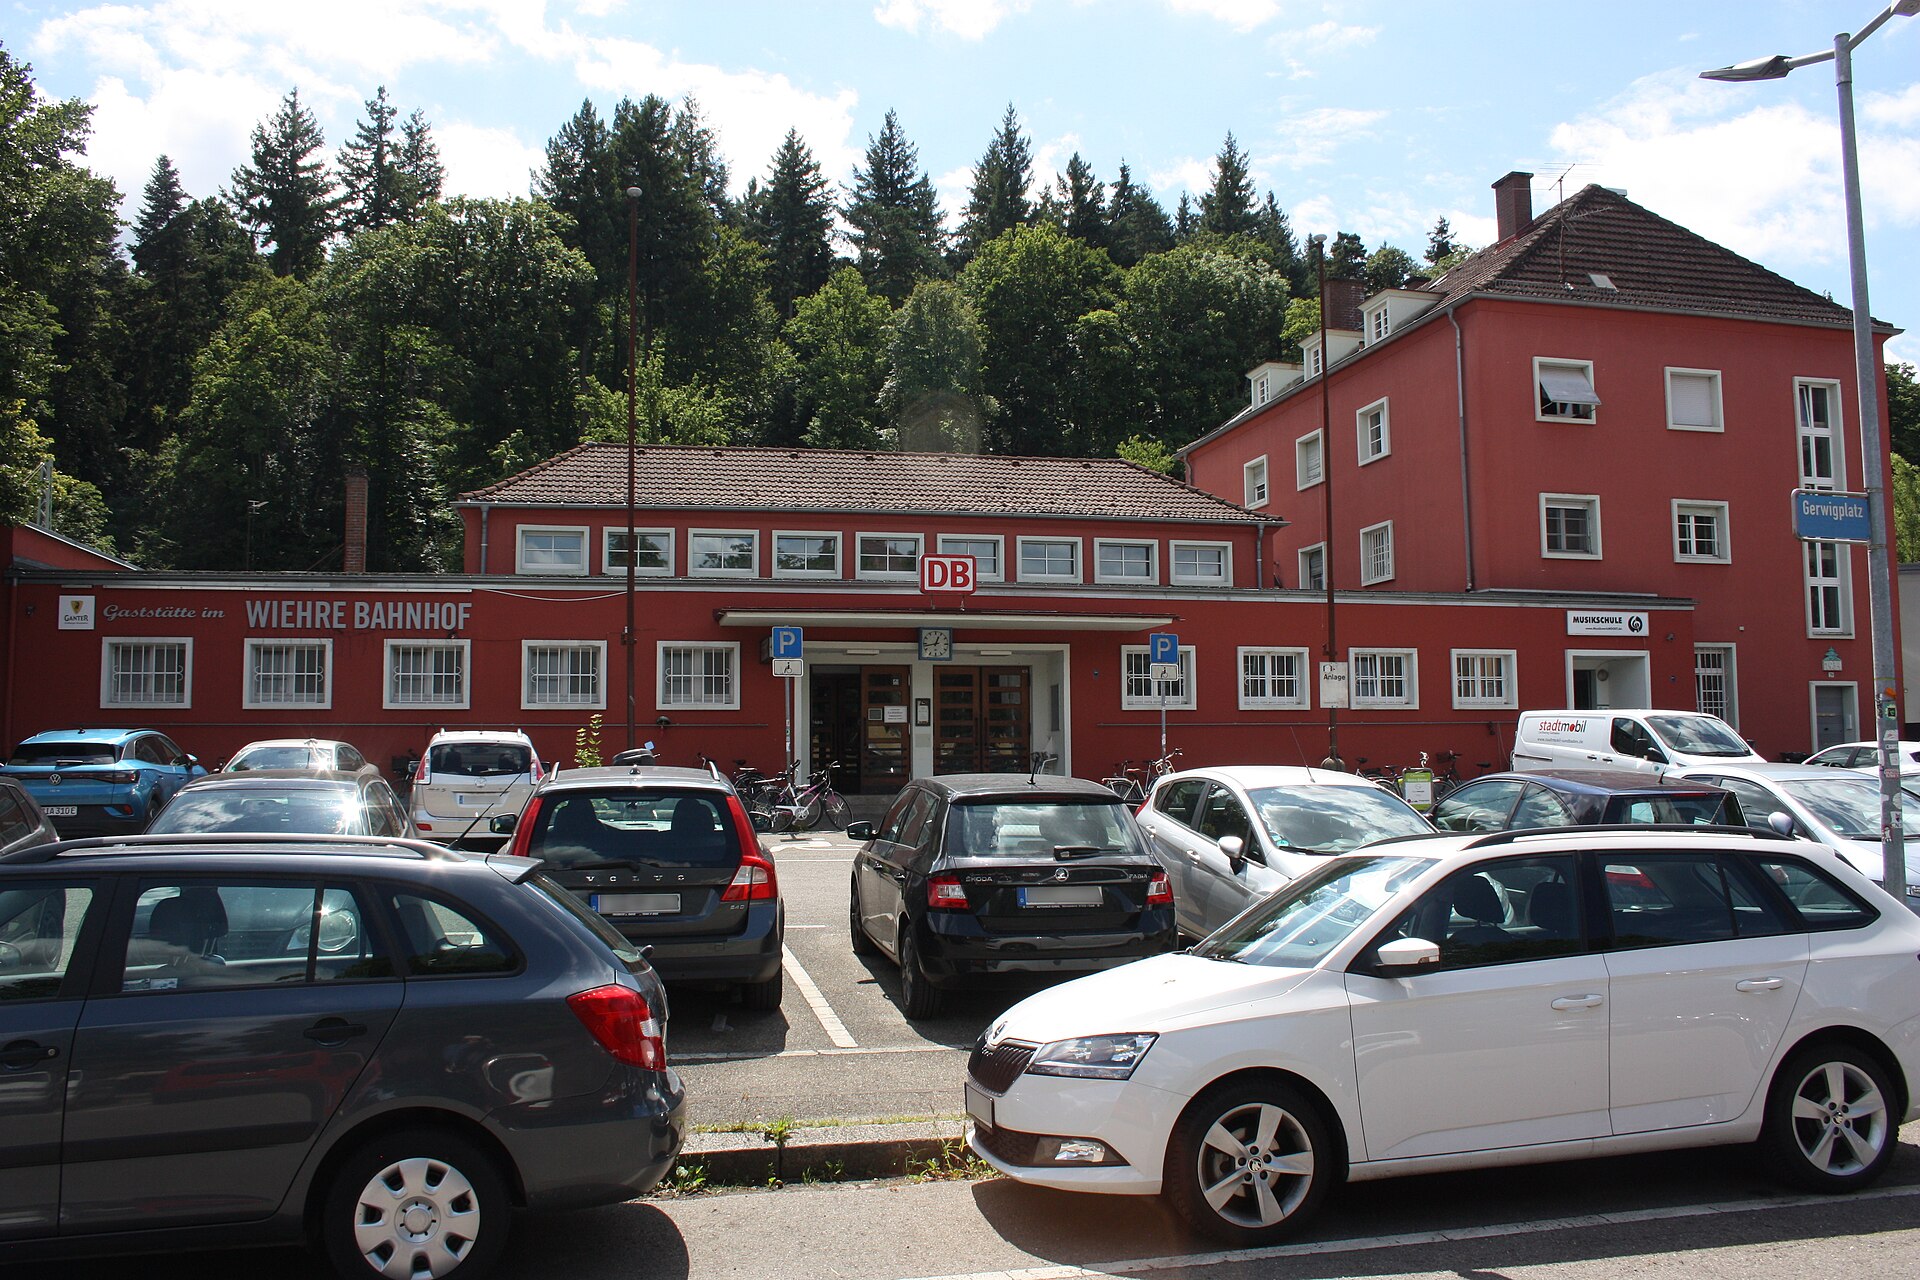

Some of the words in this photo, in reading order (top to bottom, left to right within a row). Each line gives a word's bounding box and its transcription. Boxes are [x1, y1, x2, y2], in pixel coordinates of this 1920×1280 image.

[1802, 500, 1864, 520] Gerwigplatz
[928, 560, 971, 588] DB
[64, 614, 89, 622] GANTER
[103, 604, 197, 622] Gaststätte
[201, 607, 225, 618] im
[245, 600, 347, 629] WIEHRE
[354, 601, 473, 630] BAHNHOF
[1572, 616, 1623, 624] MUSIKSCHULE
[779, 631, 796, 654] P
[1157, 637, 1171, 660] P
[1323, 673, 1346, 681] Anlage
[1538, 719, 1588, 733] stadtmobil
